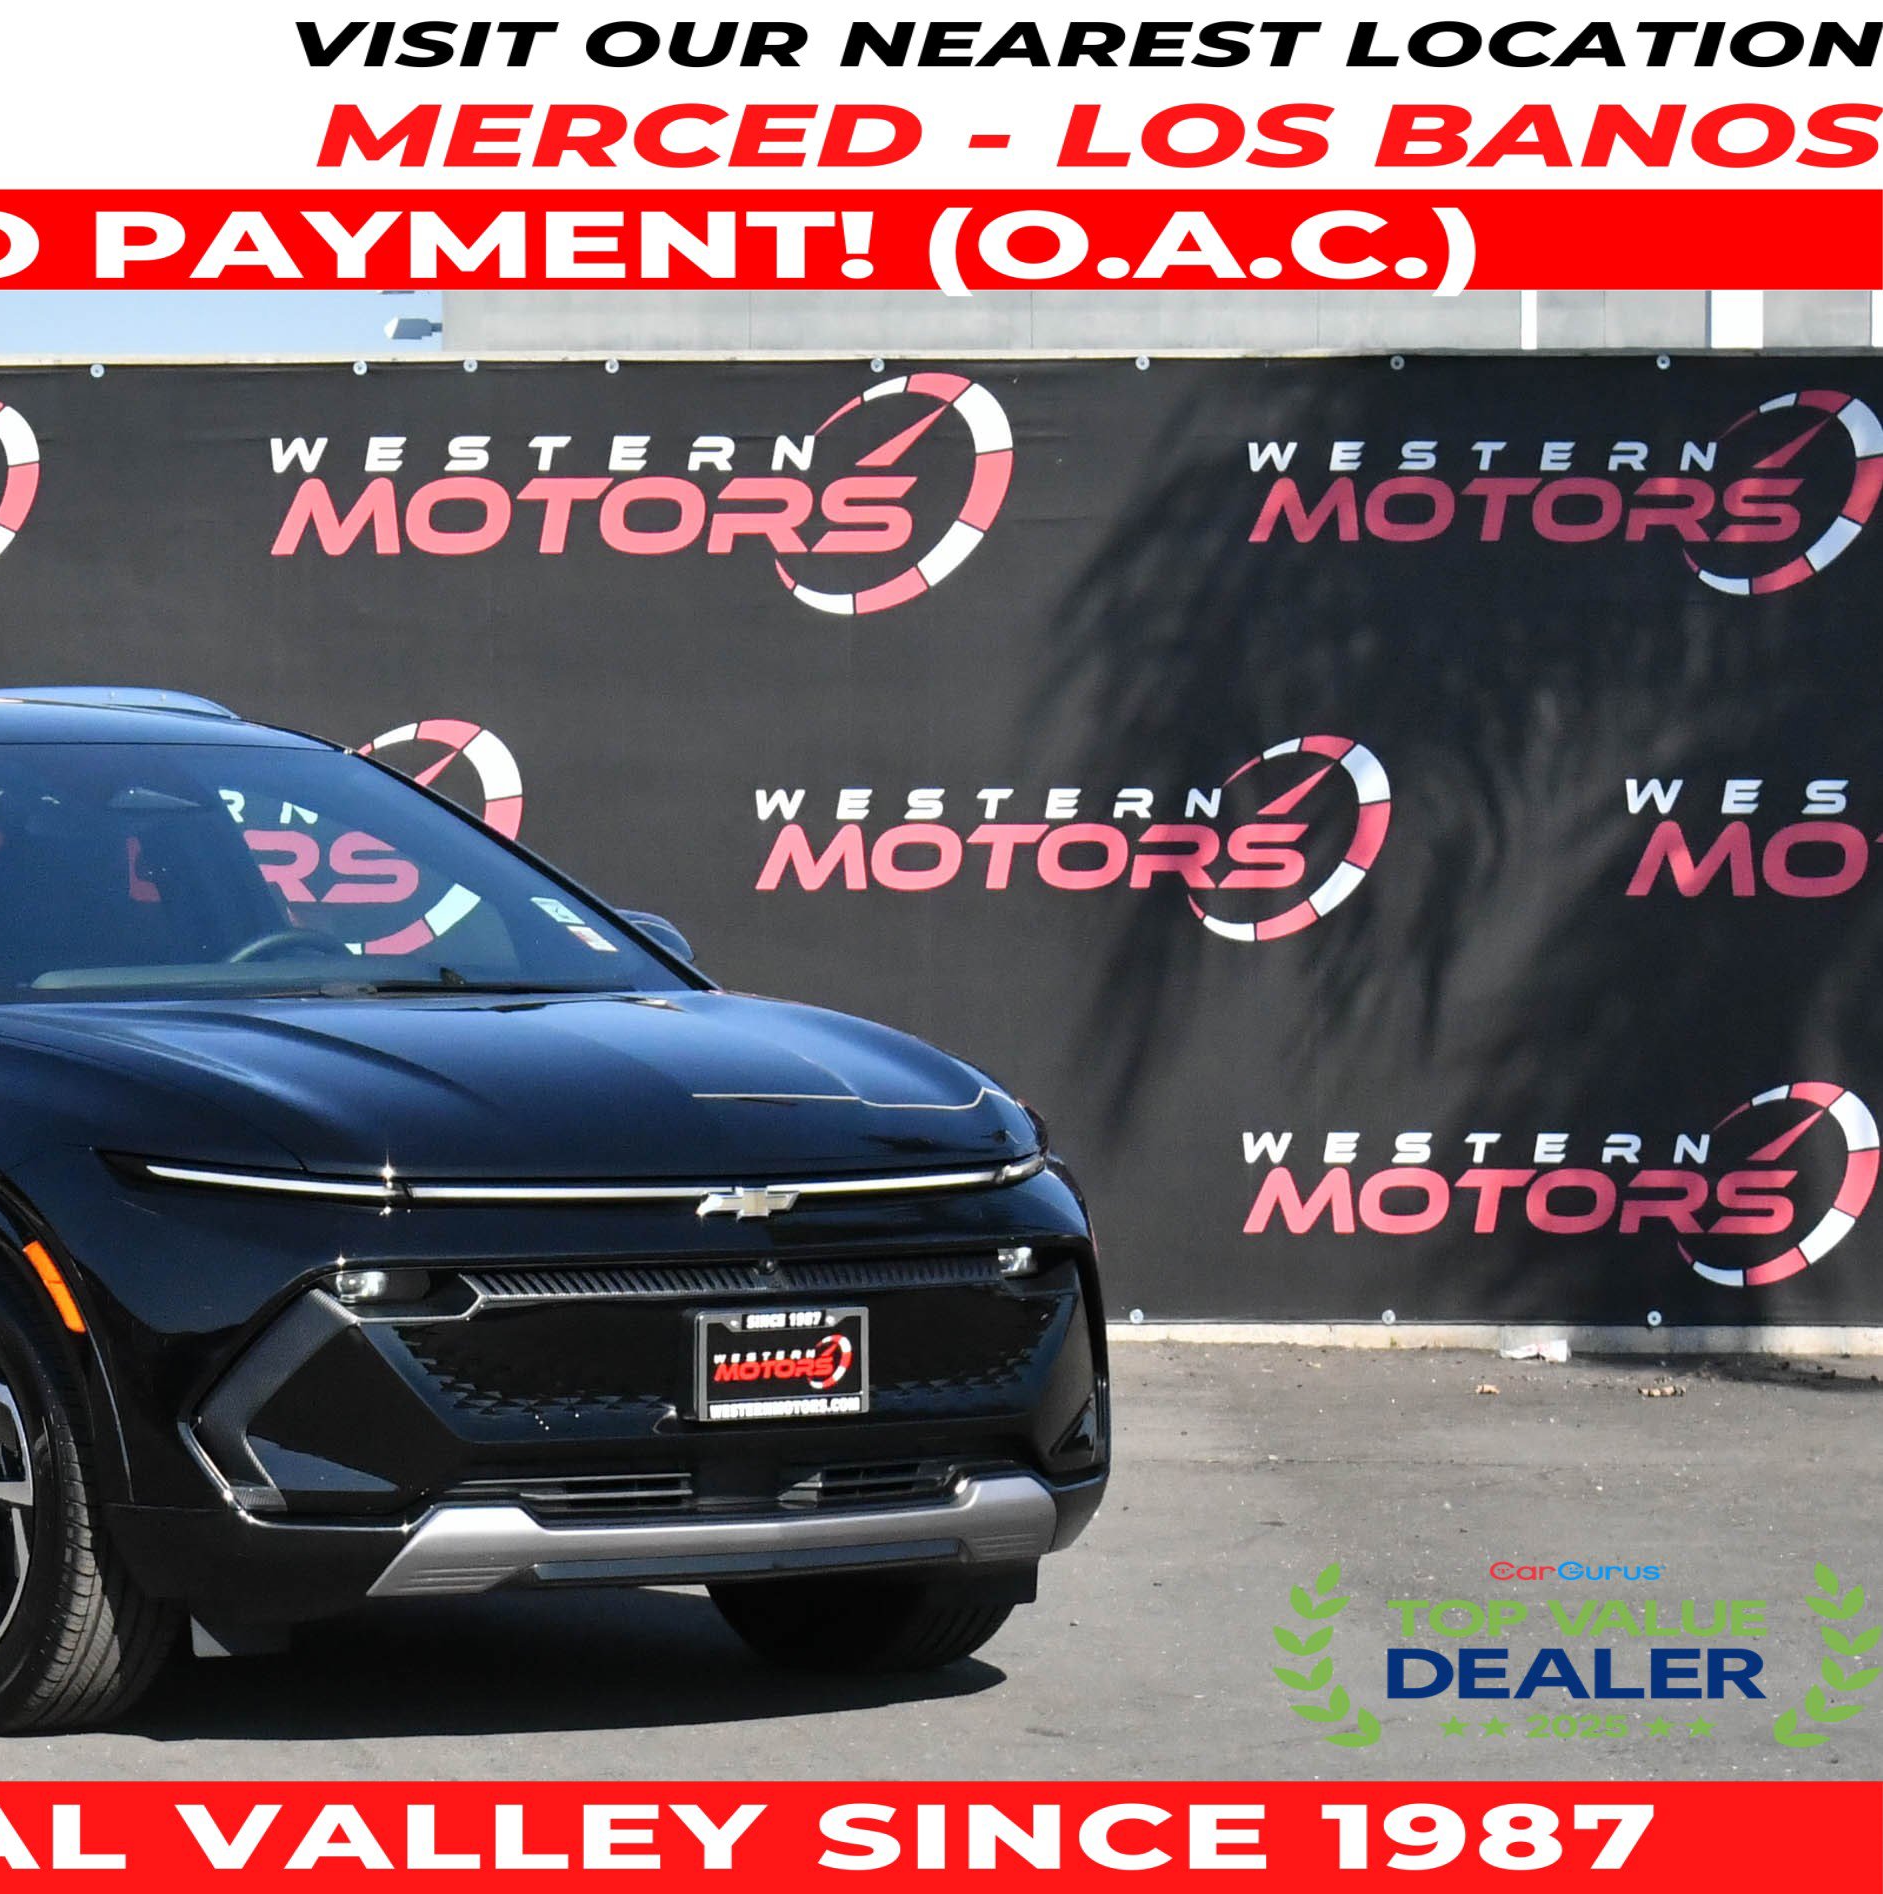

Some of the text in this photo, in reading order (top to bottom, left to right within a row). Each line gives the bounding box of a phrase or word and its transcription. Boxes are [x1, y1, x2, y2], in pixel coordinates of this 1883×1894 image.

[270, 434, 816, 474] WESTERN
[1248, 440, 1717, 473] WESTERN
[271, 476, 919, 558] MOTORS
[1248, 476, 1804, 544] MOTORS
[755, 787, 1222, 821] WESTERN
[755, 822, 1308, 893] MOTORS
[1242, 1131, 1710, 1165] WESTERN
[1243, 1168, 1798, 1236] MOTORS
[746, 1311, 822, 1329] SINCE 1987
[713, 1349, 817, 1364] WESTERN
[713, 1356, 834, 1382] MOTORS
[709, 1397, 861, 1420] WESTERNMOTORS.COM
